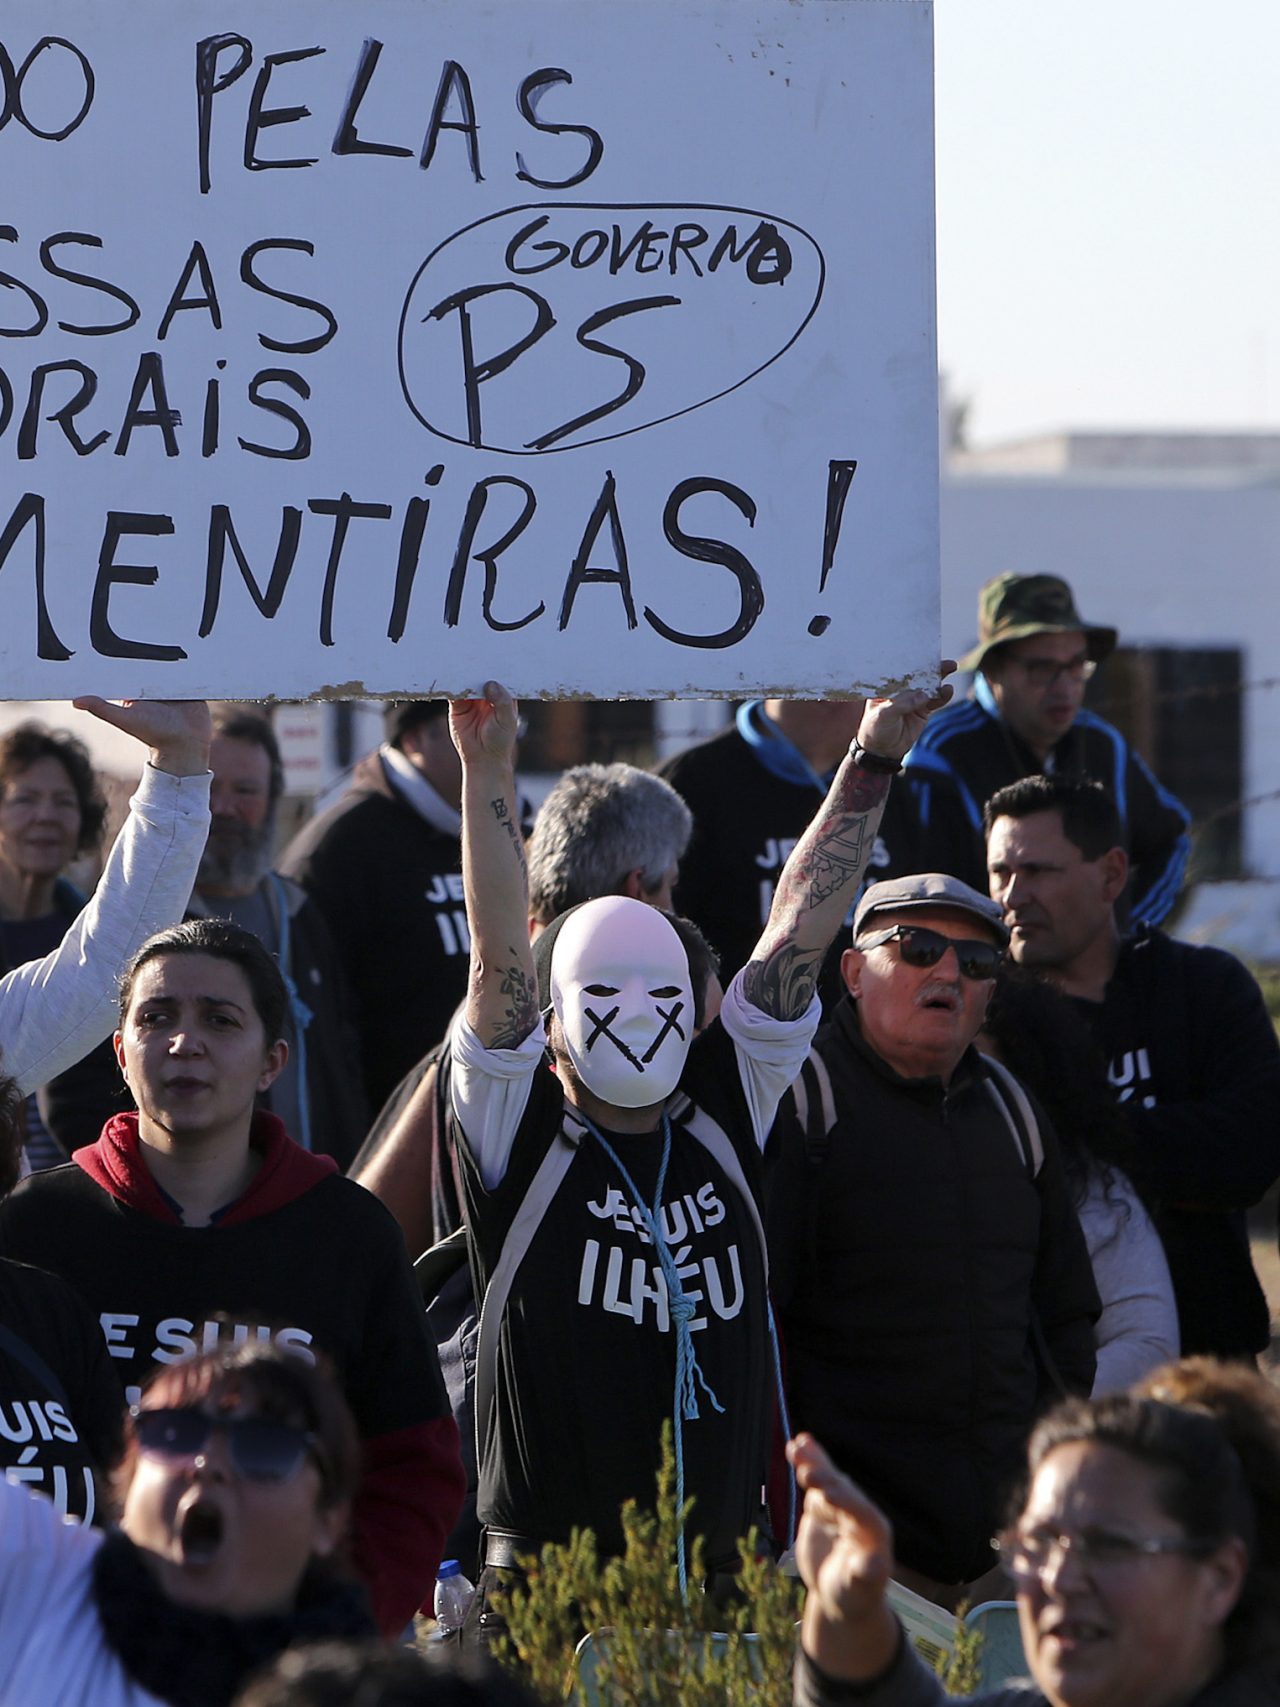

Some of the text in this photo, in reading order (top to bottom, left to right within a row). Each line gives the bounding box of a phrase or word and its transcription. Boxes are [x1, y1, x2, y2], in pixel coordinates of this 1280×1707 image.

[196, 33, 603, 194] PELAS
[505, 214, 792, 286] GOVERNO
[421, 282, 682, 449] PS
[578, 1244, 745, 1333] ILHÉU
[99, 1313, 140, 1358] E
